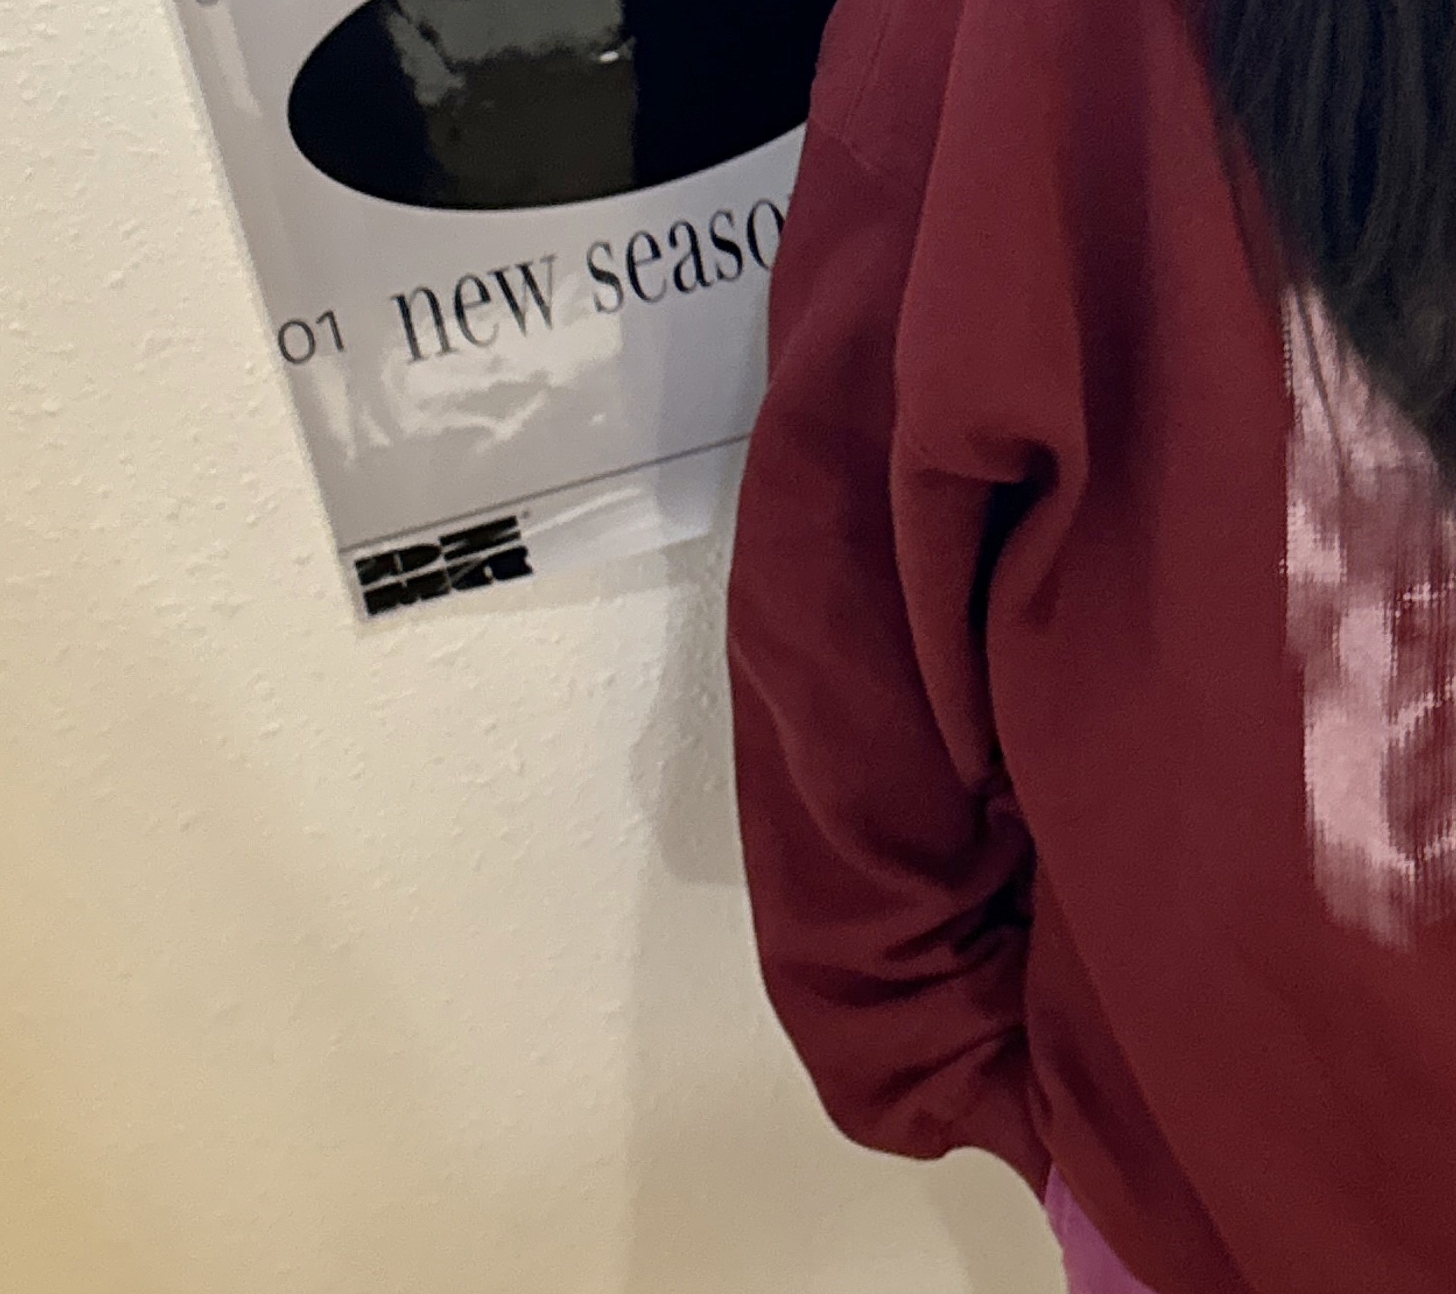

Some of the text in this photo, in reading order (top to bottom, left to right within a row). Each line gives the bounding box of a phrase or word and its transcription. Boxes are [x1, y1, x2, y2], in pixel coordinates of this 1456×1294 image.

[277, 198, 785, 366] 01 new seaso
